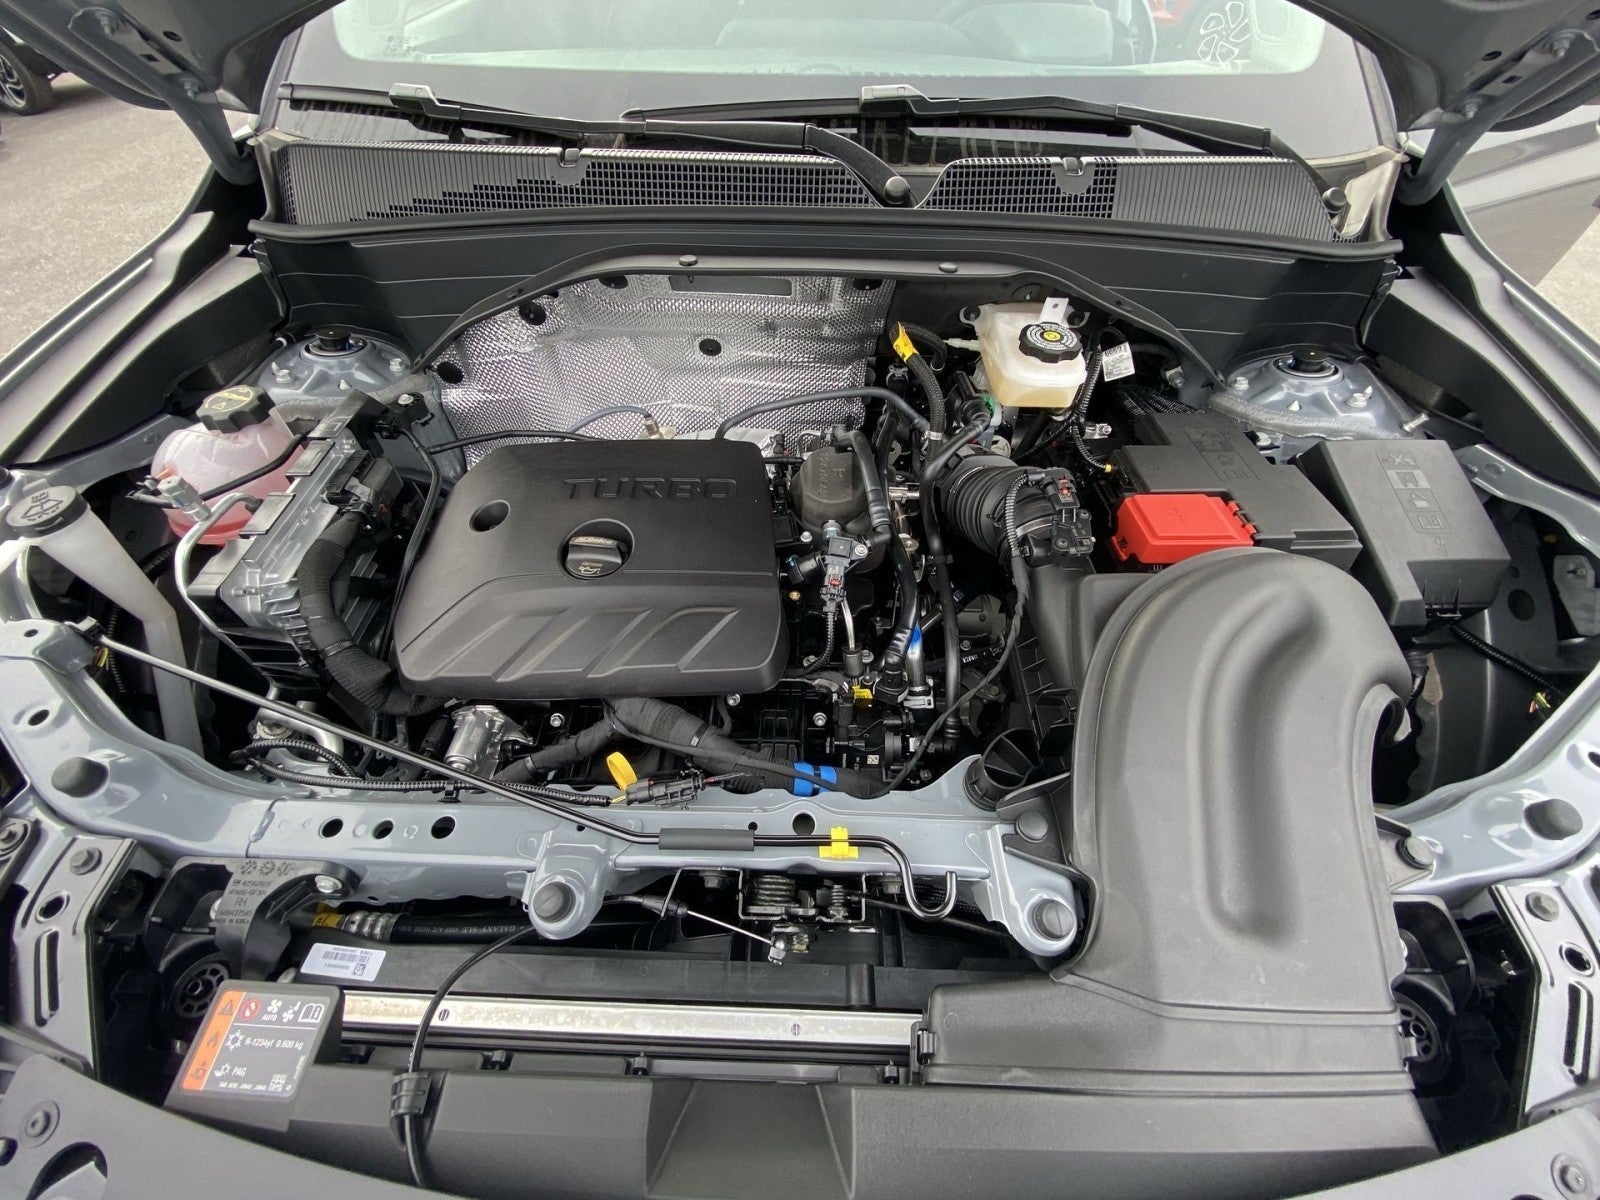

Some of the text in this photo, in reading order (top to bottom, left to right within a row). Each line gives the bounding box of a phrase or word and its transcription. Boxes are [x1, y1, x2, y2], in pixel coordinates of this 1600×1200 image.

[563, 477, 737, 499] TURBO
[261, 1013, 278, 1021] AUTO
[245, 1037, 274, 1049] R-1234yf
[294, 1040, 304, 1051] kg
[232, 1066, 246, 1076] PAG
